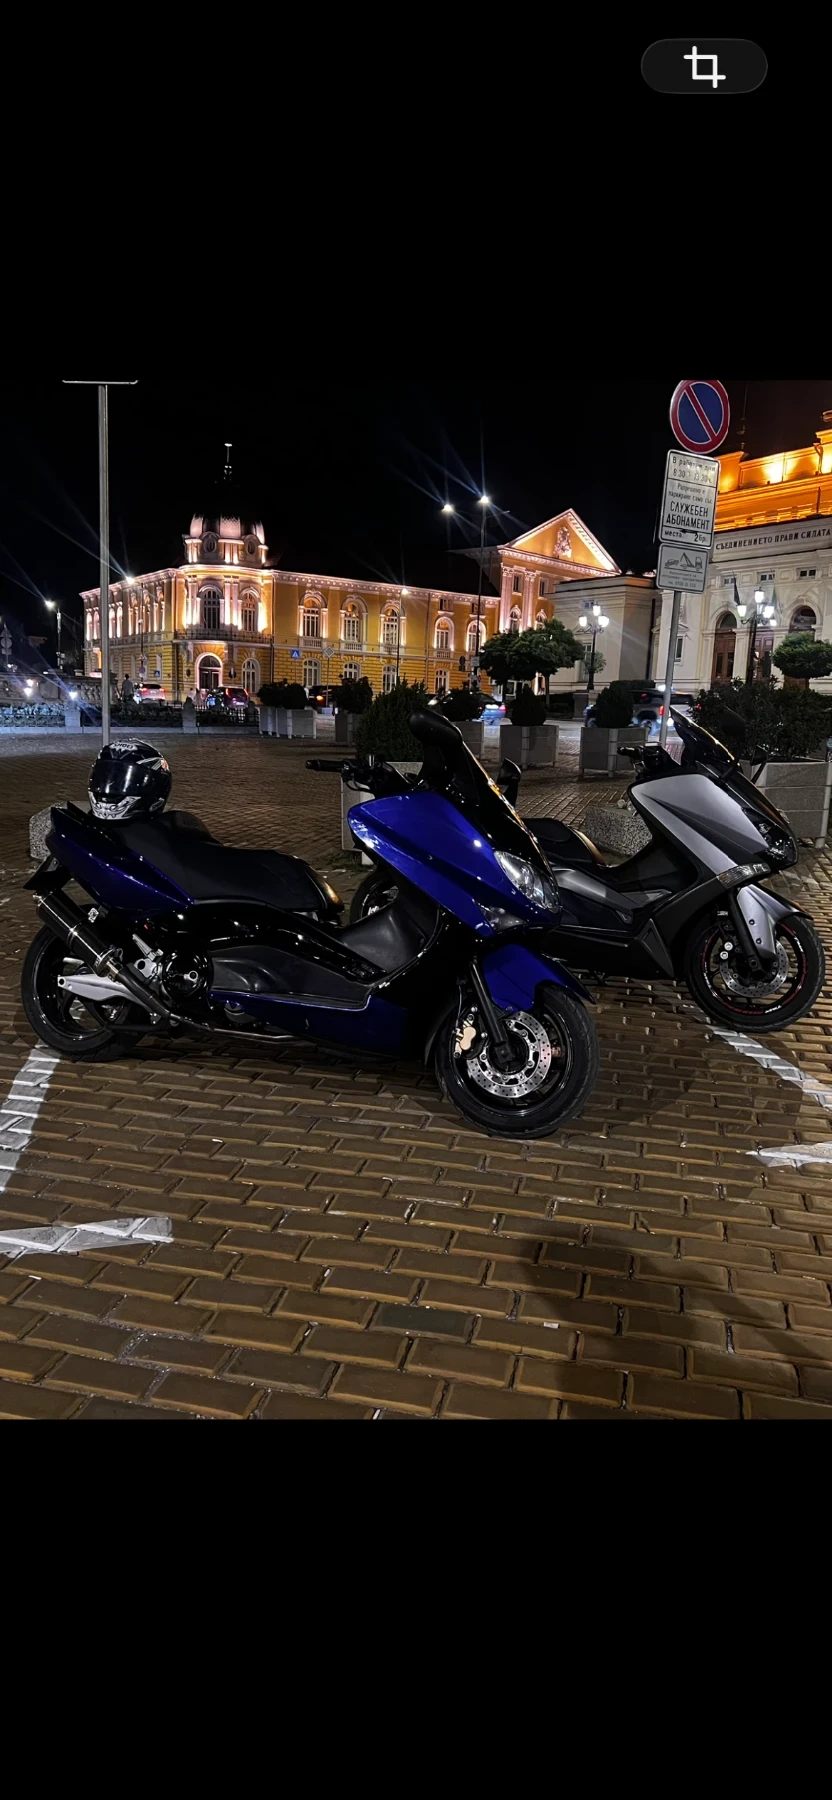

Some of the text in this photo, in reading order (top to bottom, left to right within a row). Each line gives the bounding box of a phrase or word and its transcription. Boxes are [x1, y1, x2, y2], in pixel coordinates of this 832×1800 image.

[670, 500, 709, 517] СЛУЖЕБЕН
[666, 513, 710, 530] АБОНАМЕНТ
[715, 528, 831, 550] СЪЕДИНЕНИЕТО ПРАВИ СИЛАТА
